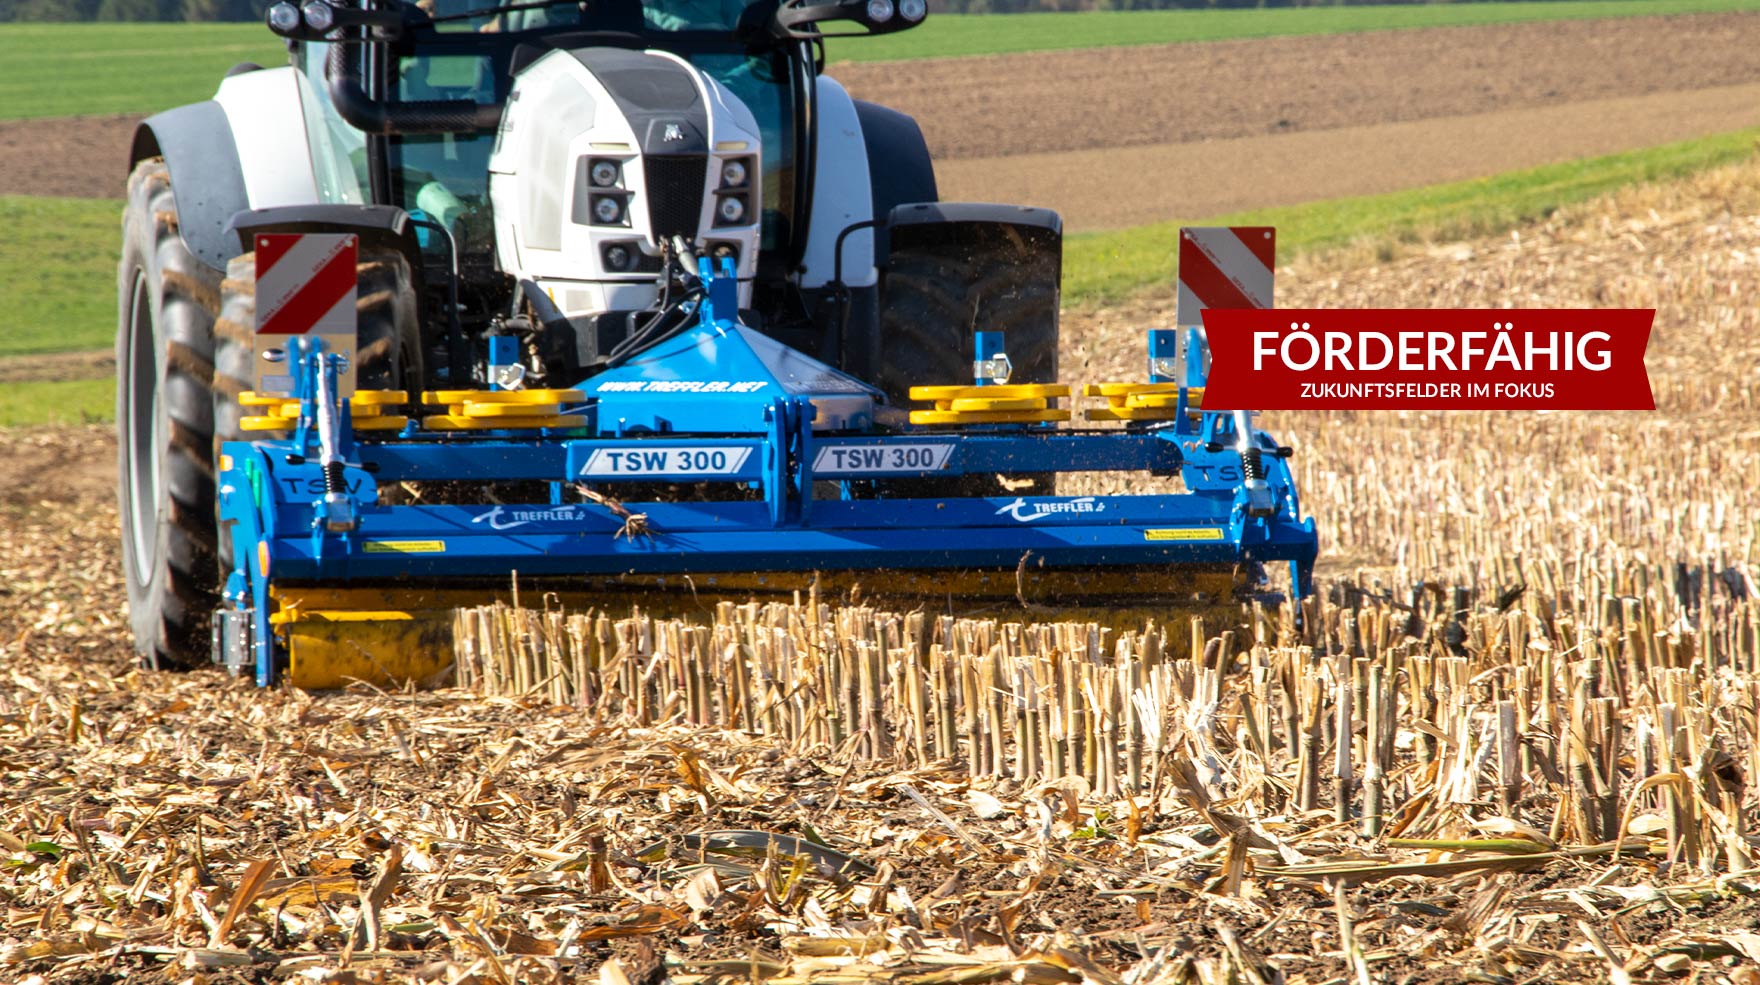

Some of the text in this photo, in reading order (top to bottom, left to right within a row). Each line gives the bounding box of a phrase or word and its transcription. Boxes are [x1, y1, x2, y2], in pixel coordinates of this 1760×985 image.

[606, 451, 727, 472] TSW 300
[832, 448, 934, 469] TSW 300
[1033, 502, 1093, 513] TREFFLER
[512, 511, 574, 521] TREFFLER
